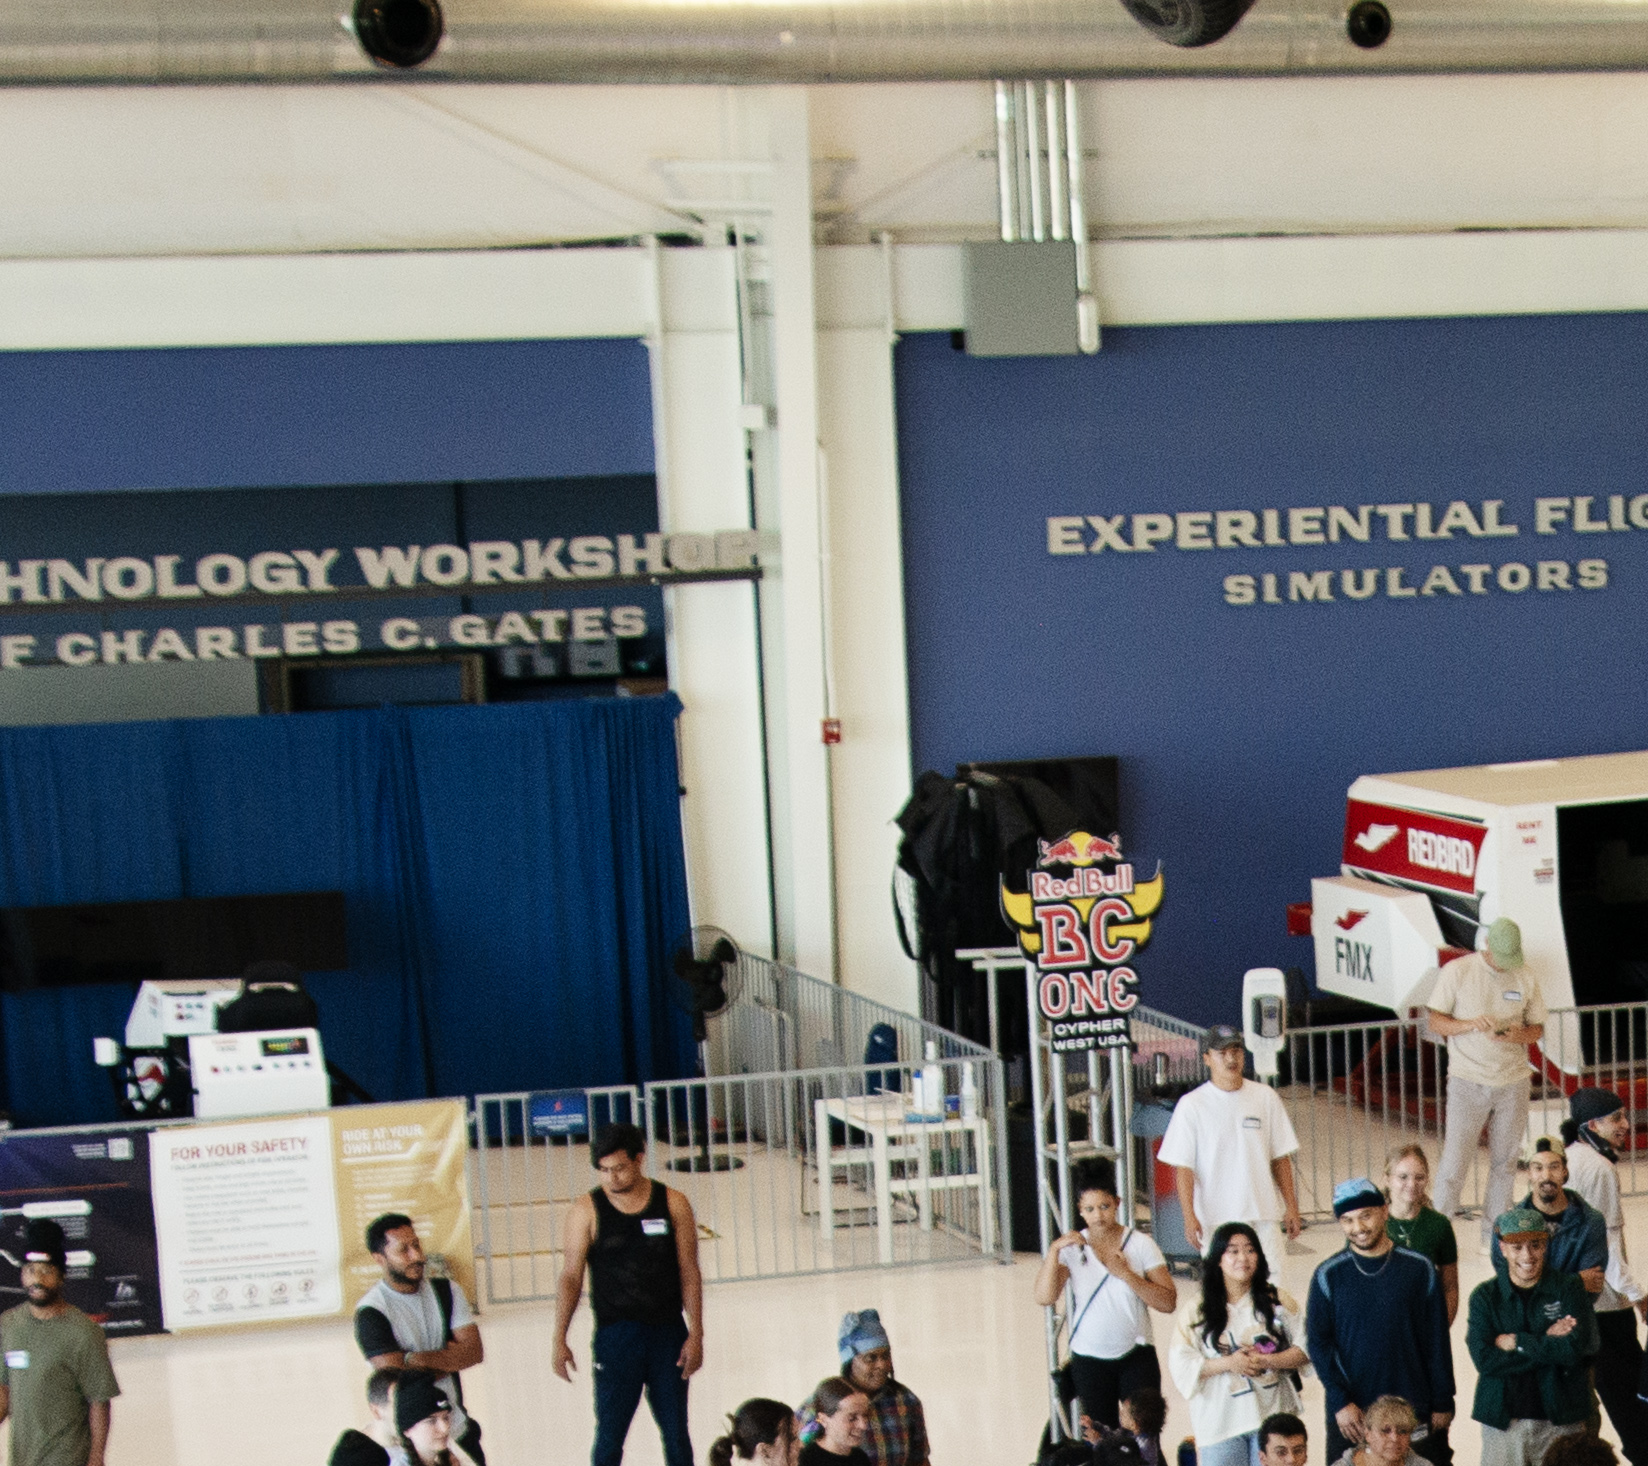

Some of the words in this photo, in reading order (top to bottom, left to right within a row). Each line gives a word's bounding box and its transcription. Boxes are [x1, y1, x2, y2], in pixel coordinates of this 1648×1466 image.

[1047, 498, 1519, 555] EXPERIENTIAL
[355, 529, 767, 590] WORKSHOP
[1222, 558, 1610, 605] SIMULATORS
[55, 620, 361, 666] CHARLES
[381, 615, 437, 651] C.
[452, 604, 648, 647] GATES
[1407, 827, 1476, 878] REDBIRD
[1031, 867, 1082, 900] Red
[1084, 863, 1134, 895] Bull
[1034, 897, 1135, 969] BC
[1335, 935, 1375, 983] FMX
[1039, 966, 1140, 1021] ONE
[1053, 1036, 1094, 1051] WEST
[1098, 1033, 1130, 1046] USA
[1054, 1018, 1126, 1036] CYPHER
[170, 1145, 201, 1162] FOR
[204, 1139, 247, 1159] YOUR
[250, 1136, 308, 1155] SAFETY
[341, 1127, 370, 1143] RIDE
[372, 1126, 386, 1141] AT
[388, 1123, 423, 1139] YOUR
